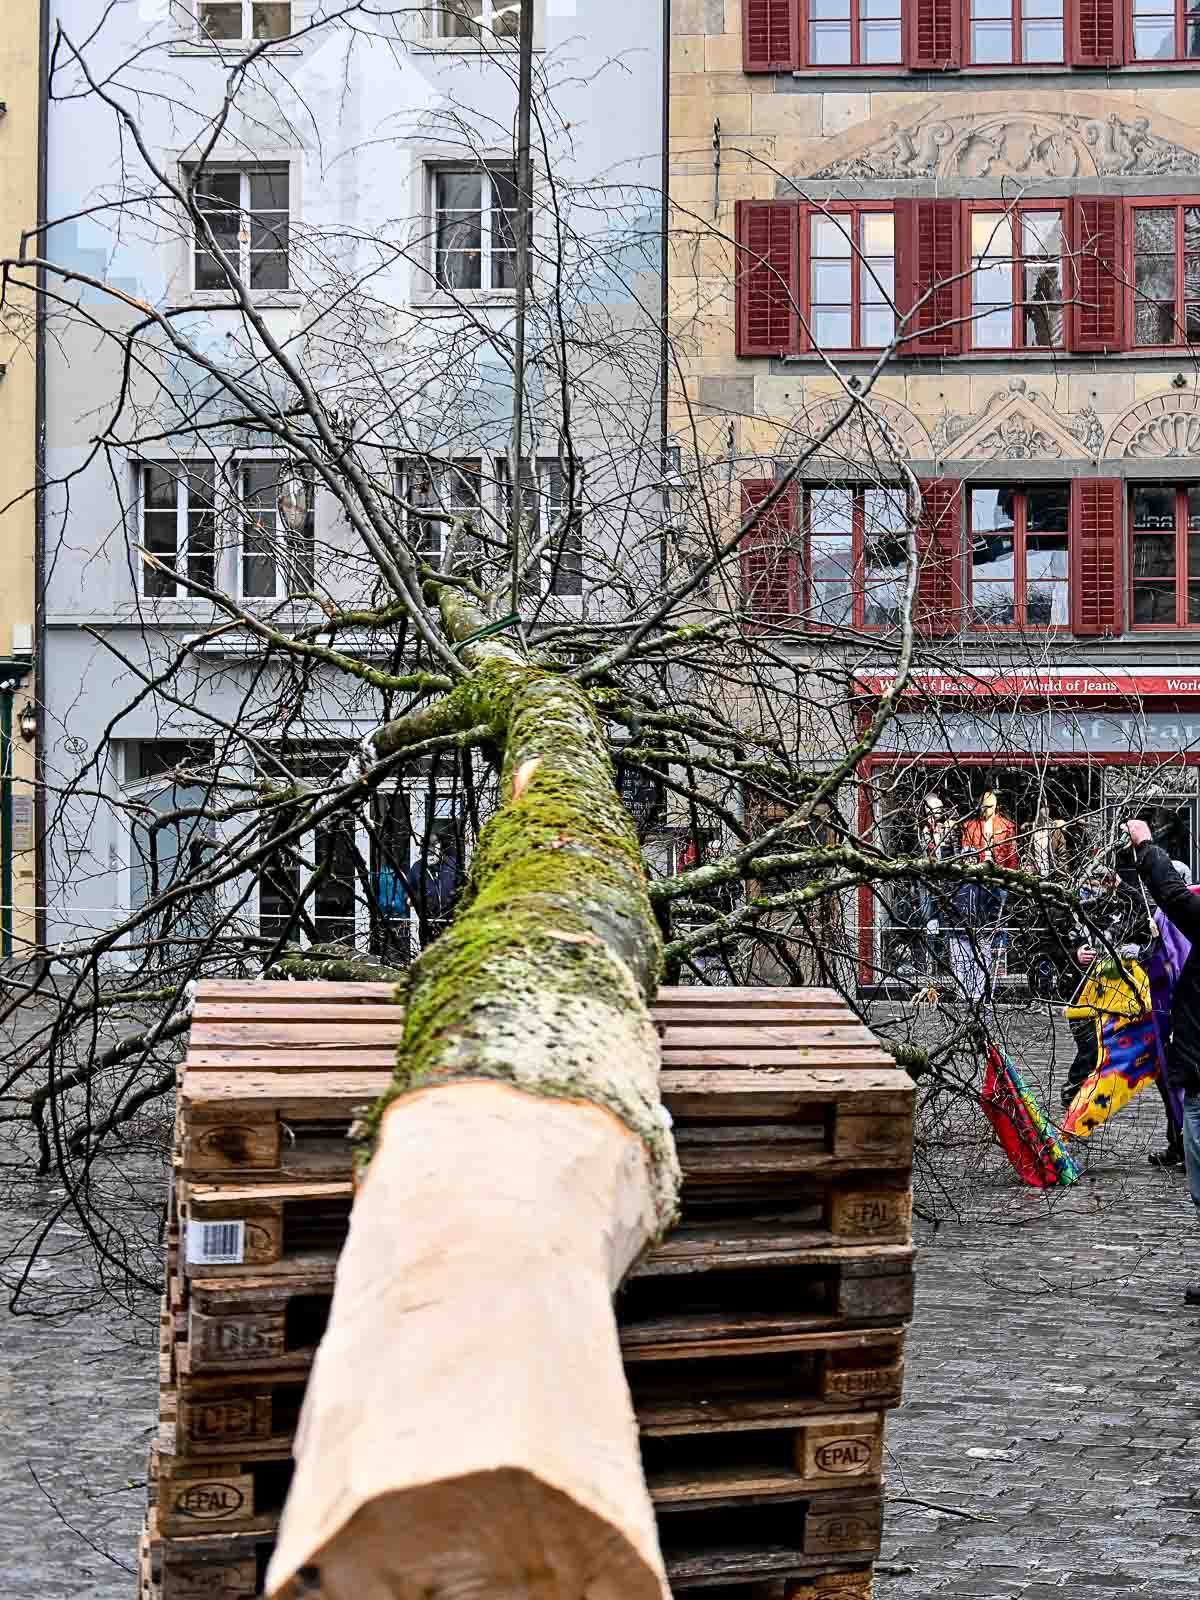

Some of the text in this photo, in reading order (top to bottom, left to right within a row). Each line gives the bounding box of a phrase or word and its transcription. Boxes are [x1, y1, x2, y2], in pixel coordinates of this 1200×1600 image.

[1023, 679, 1118, 694] World of Jeans
[822, 1447, 864, 1466] EPAL
